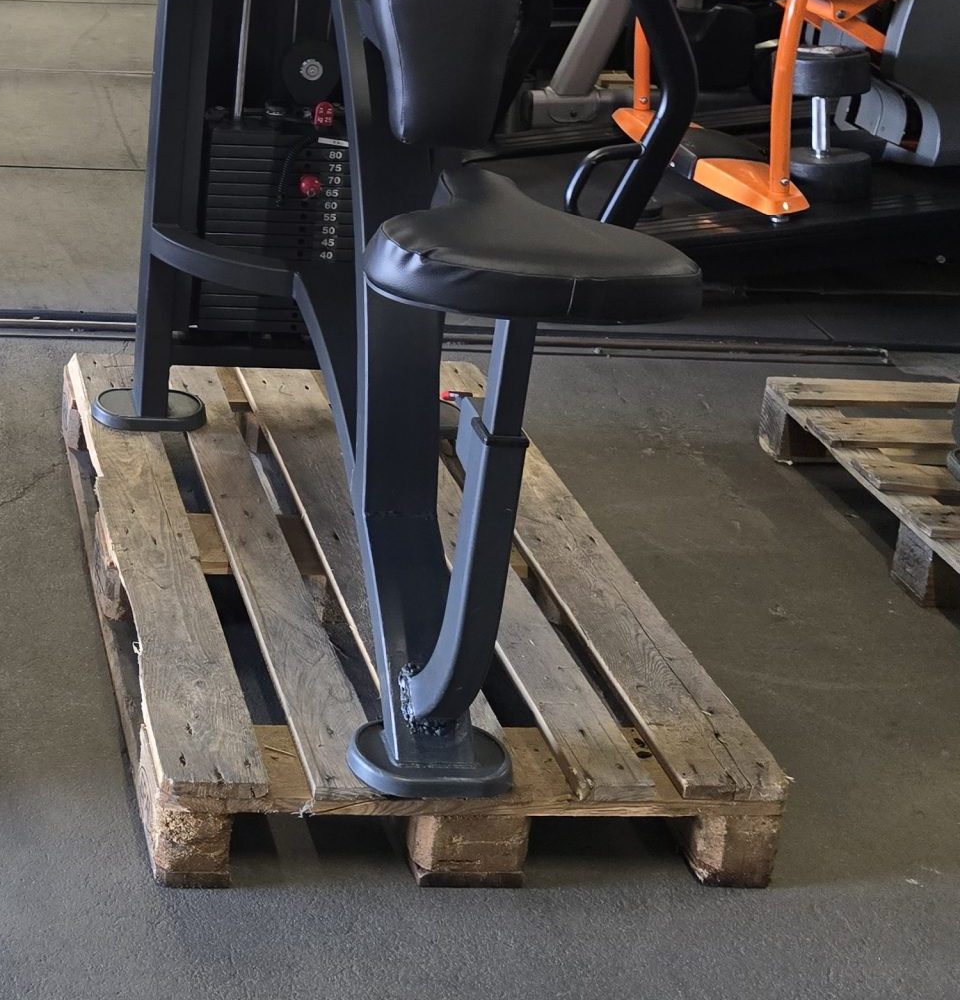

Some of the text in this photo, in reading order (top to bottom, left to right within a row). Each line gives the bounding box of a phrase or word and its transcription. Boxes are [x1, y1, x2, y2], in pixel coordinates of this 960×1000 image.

[329, 151, 343, 159] 80
[329, 164, 342, 172] 75
[328, 176, 341, 184] 70
[325, 189, 339, 197] 65
[324, 201, 338, 210] 60
[323, 213, 337, 221] 55
[322, 226, 336, 234] 50
[321, 238, 335, 246] 45
[320, 251, 333, 259] 40
